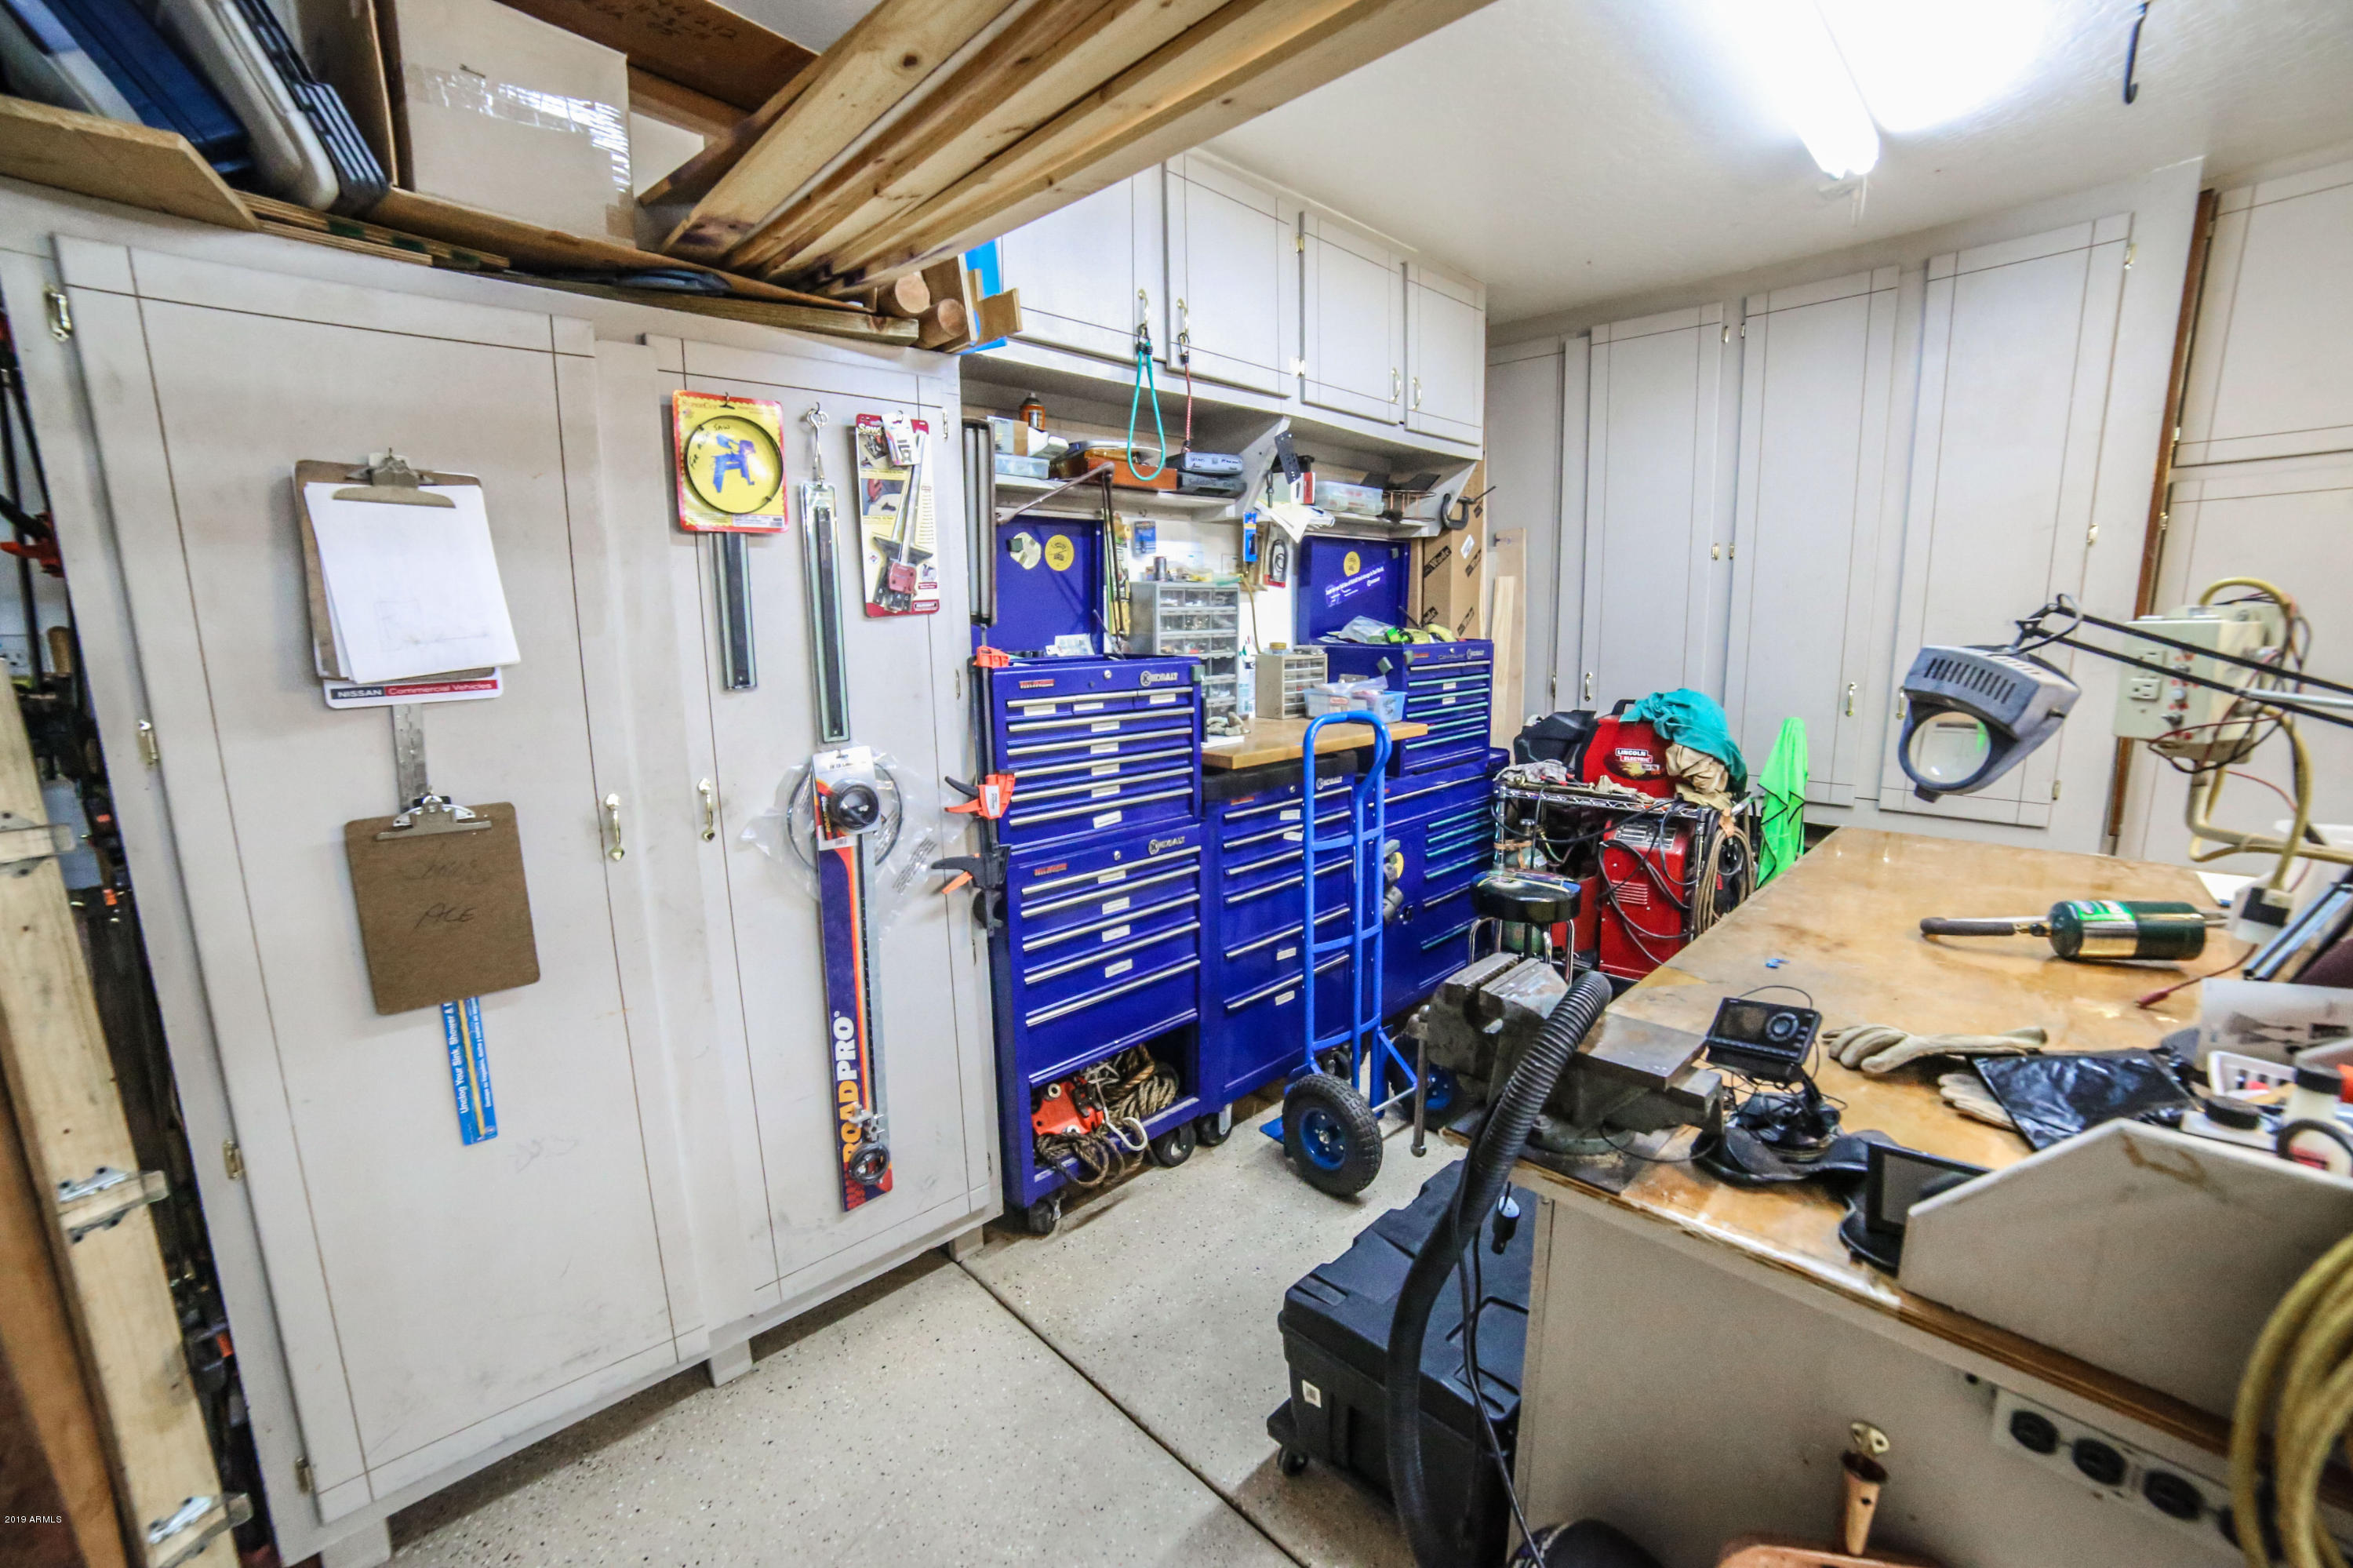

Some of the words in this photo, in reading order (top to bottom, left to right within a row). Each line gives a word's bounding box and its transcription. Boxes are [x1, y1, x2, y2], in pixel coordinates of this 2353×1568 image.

[1150, 671, 1179, 682] KOBALT
[337, 688, 383, 698] NISSAN
[388, 685, 451, 696] Commercial
[453, 682, 493, 691] Vehicles
[1158, 835, 1186, 849] KOBALT
[448, 1016, 459, 1046] Shower
[452, 1046, 463, 1066] Sink,
[455, 1067, 466, 1086] Your
[832, 1015, 863, 1163] ROADPRO
[456, 1086, 469, 1114] Unclog
